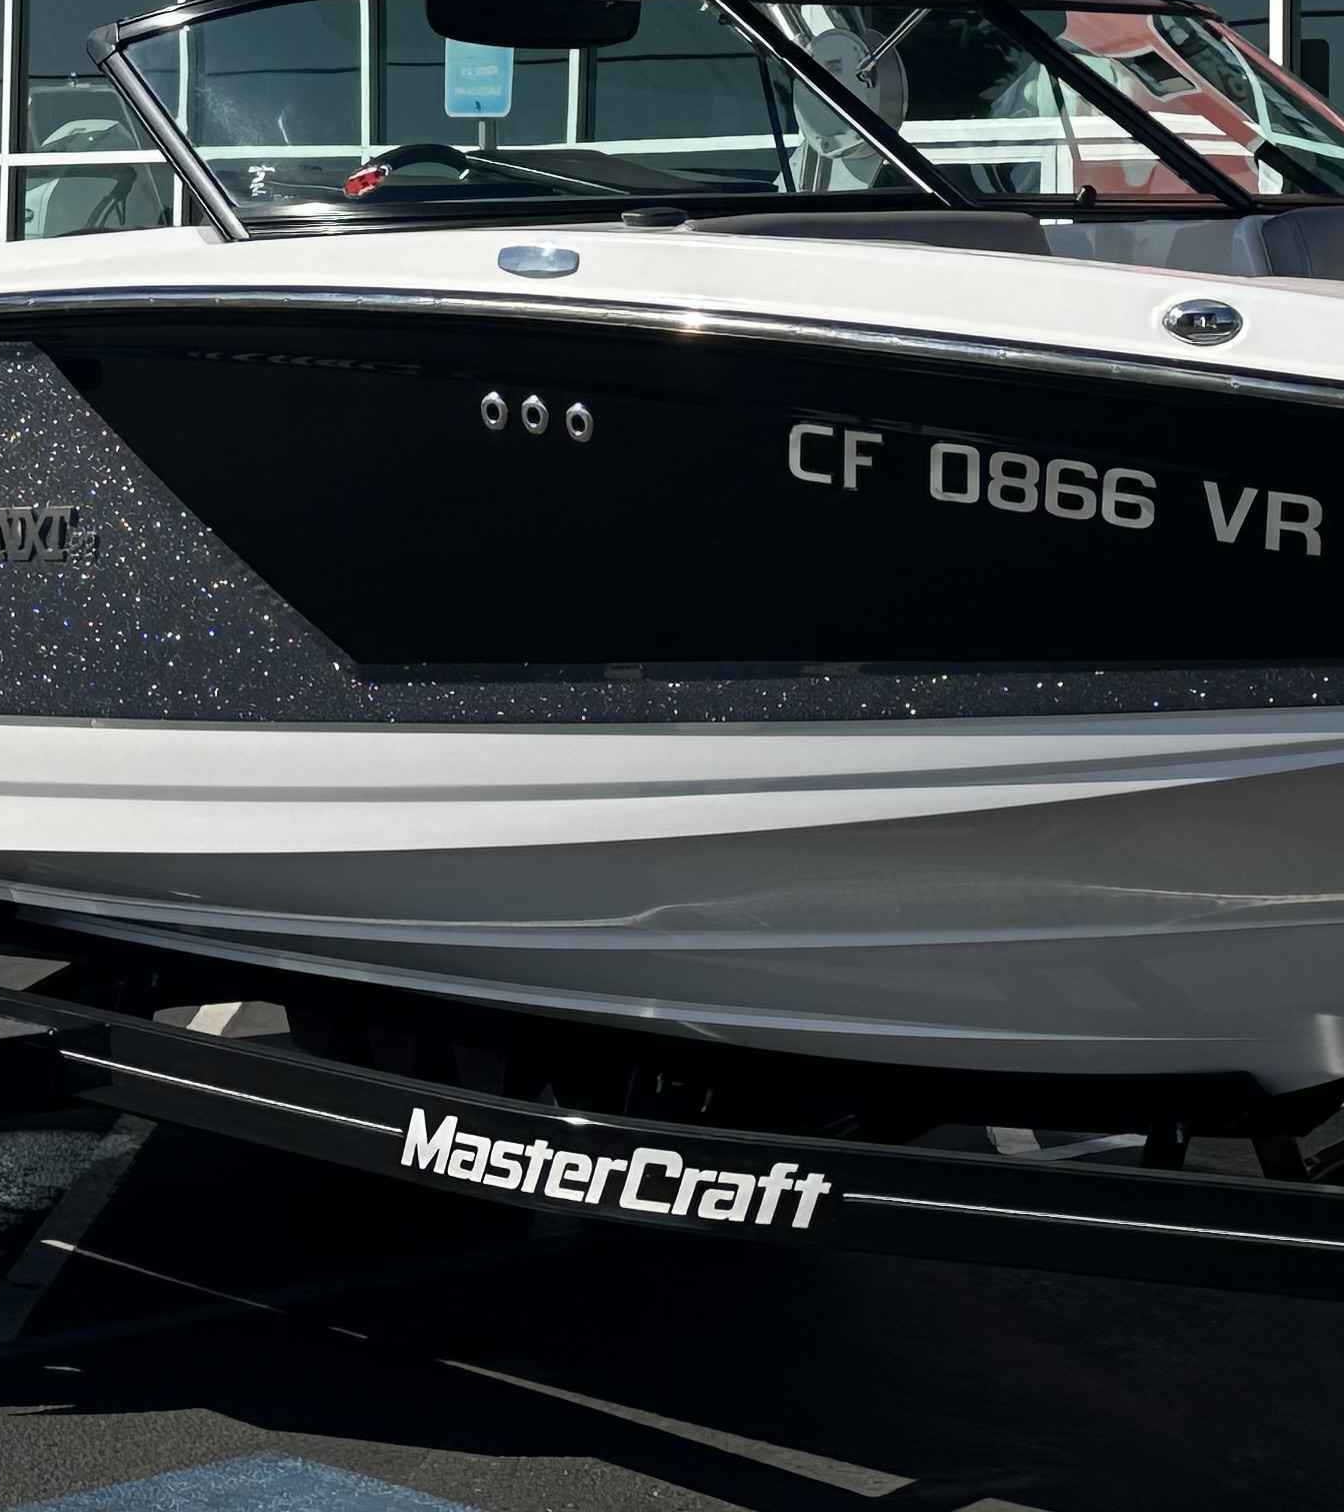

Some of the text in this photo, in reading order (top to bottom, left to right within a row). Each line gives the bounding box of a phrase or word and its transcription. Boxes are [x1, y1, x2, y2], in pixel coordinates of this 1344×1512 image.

[789, 423, 1324, 557] CF 0866 VR
[401, 1107, 832, 1229] MasterCraft
